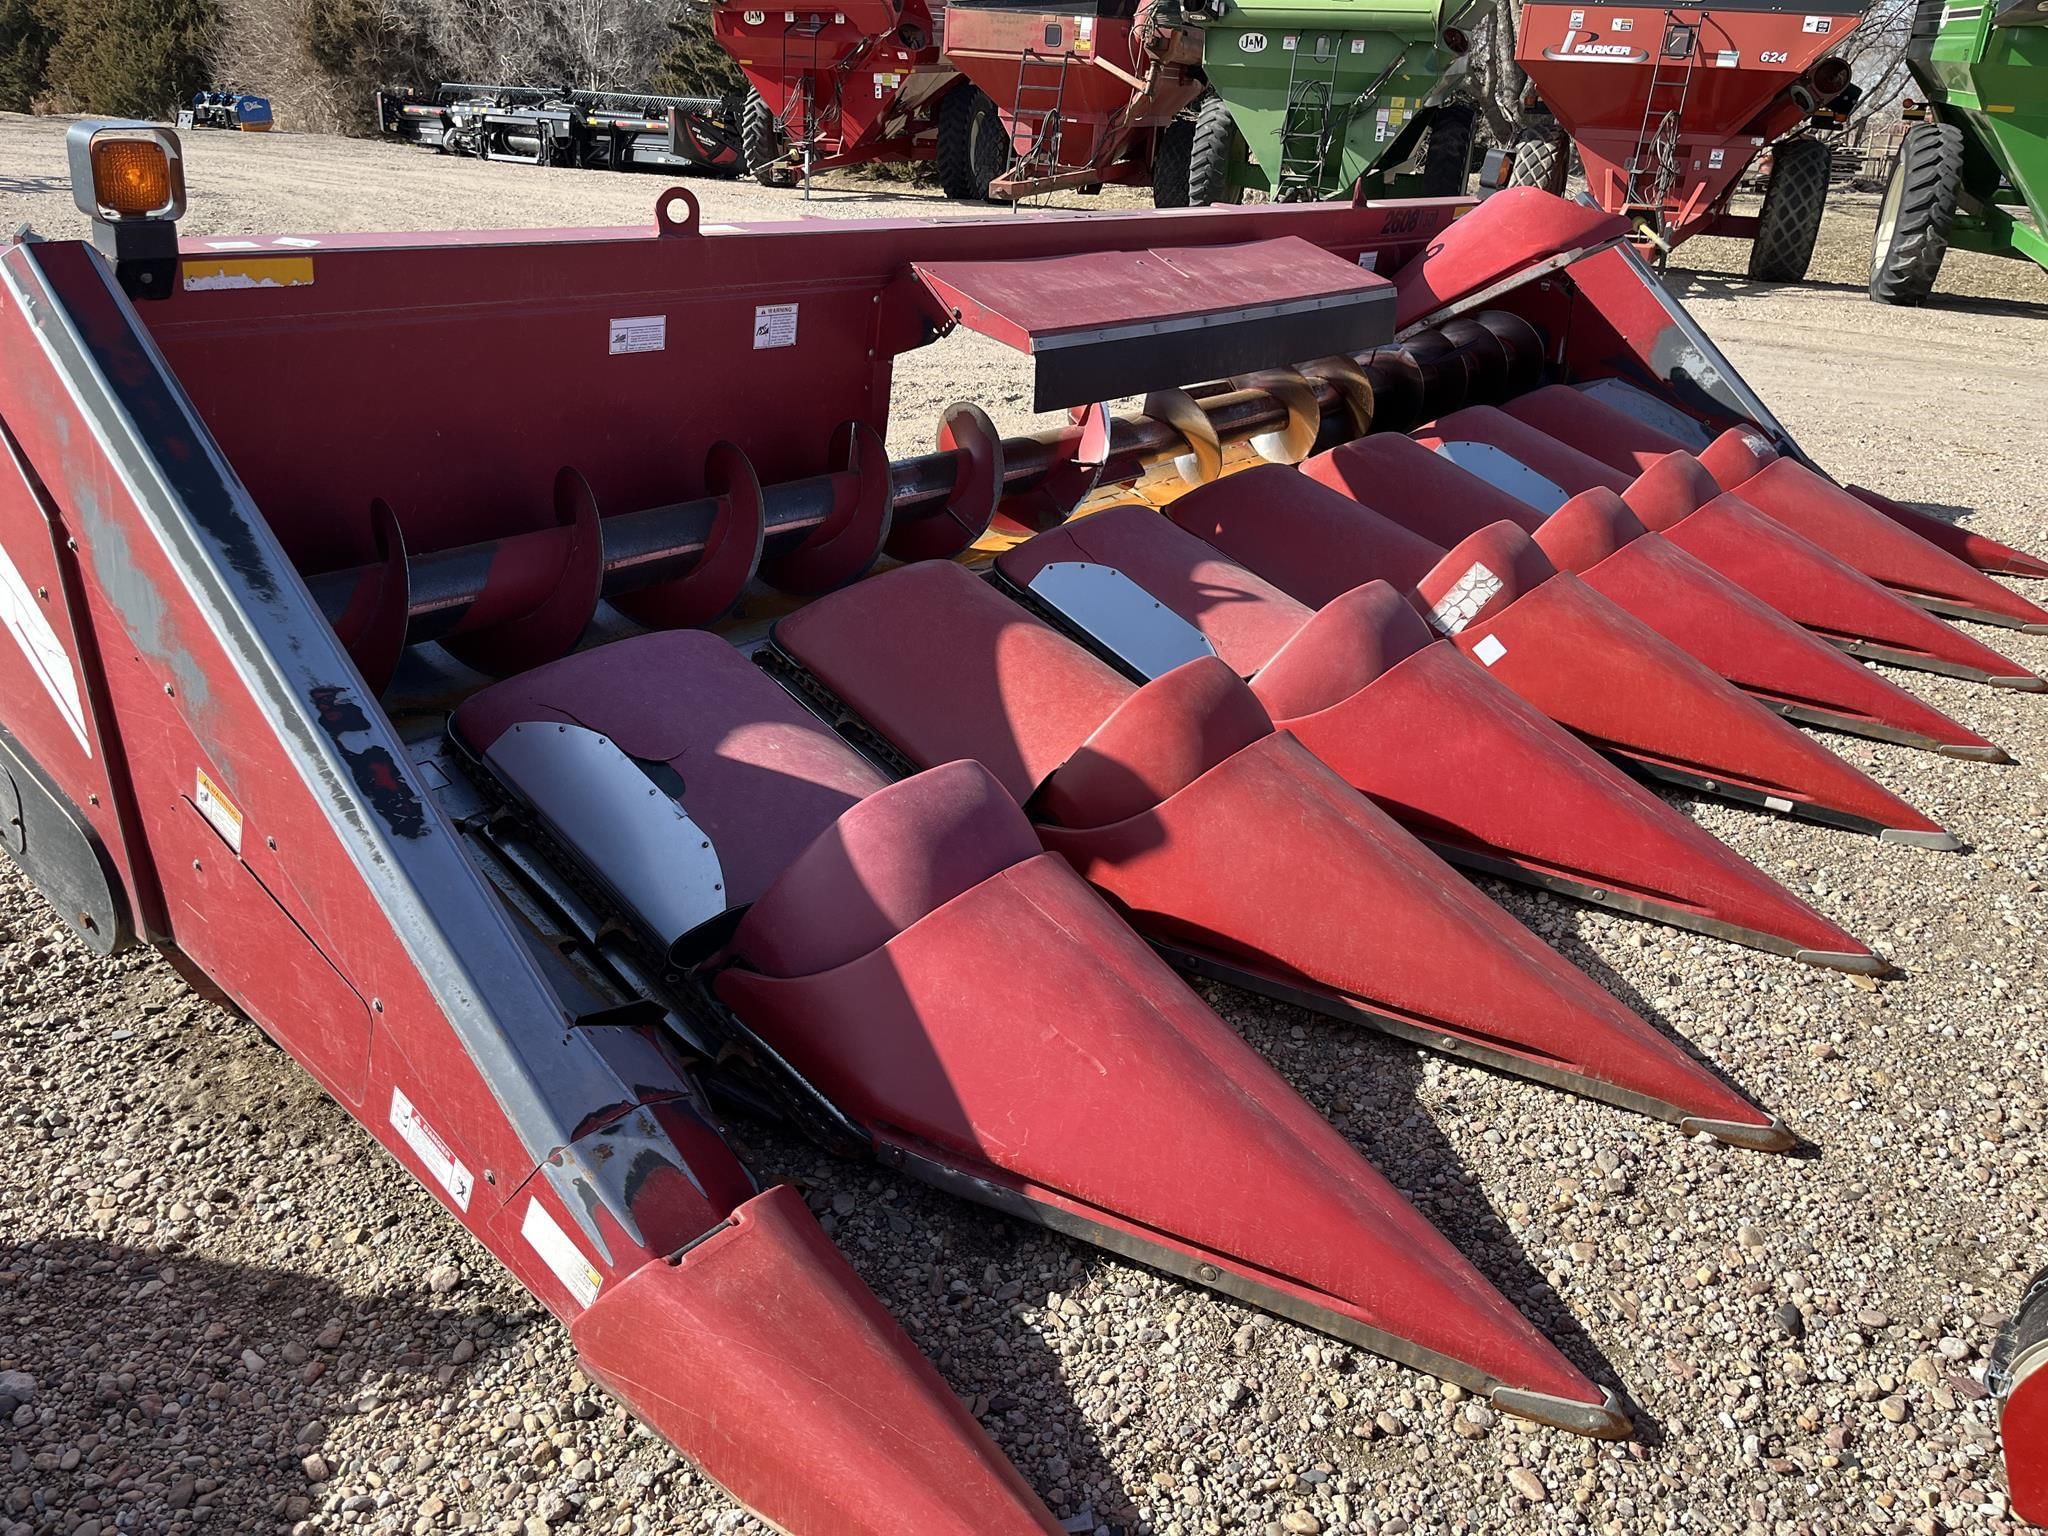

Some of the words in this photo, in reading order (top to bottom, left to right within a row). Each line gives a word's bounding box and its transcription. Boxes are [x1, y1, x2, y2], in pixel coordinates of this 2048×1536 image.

[1241, 35, 1263, 49] J&M
[1574, 44, 1632, 56] PARKER
[1760, 51, 1788, 64] 624
[768, 306, 792, 314] WARNING
[422, 1124, 451, 1160] DANGER
